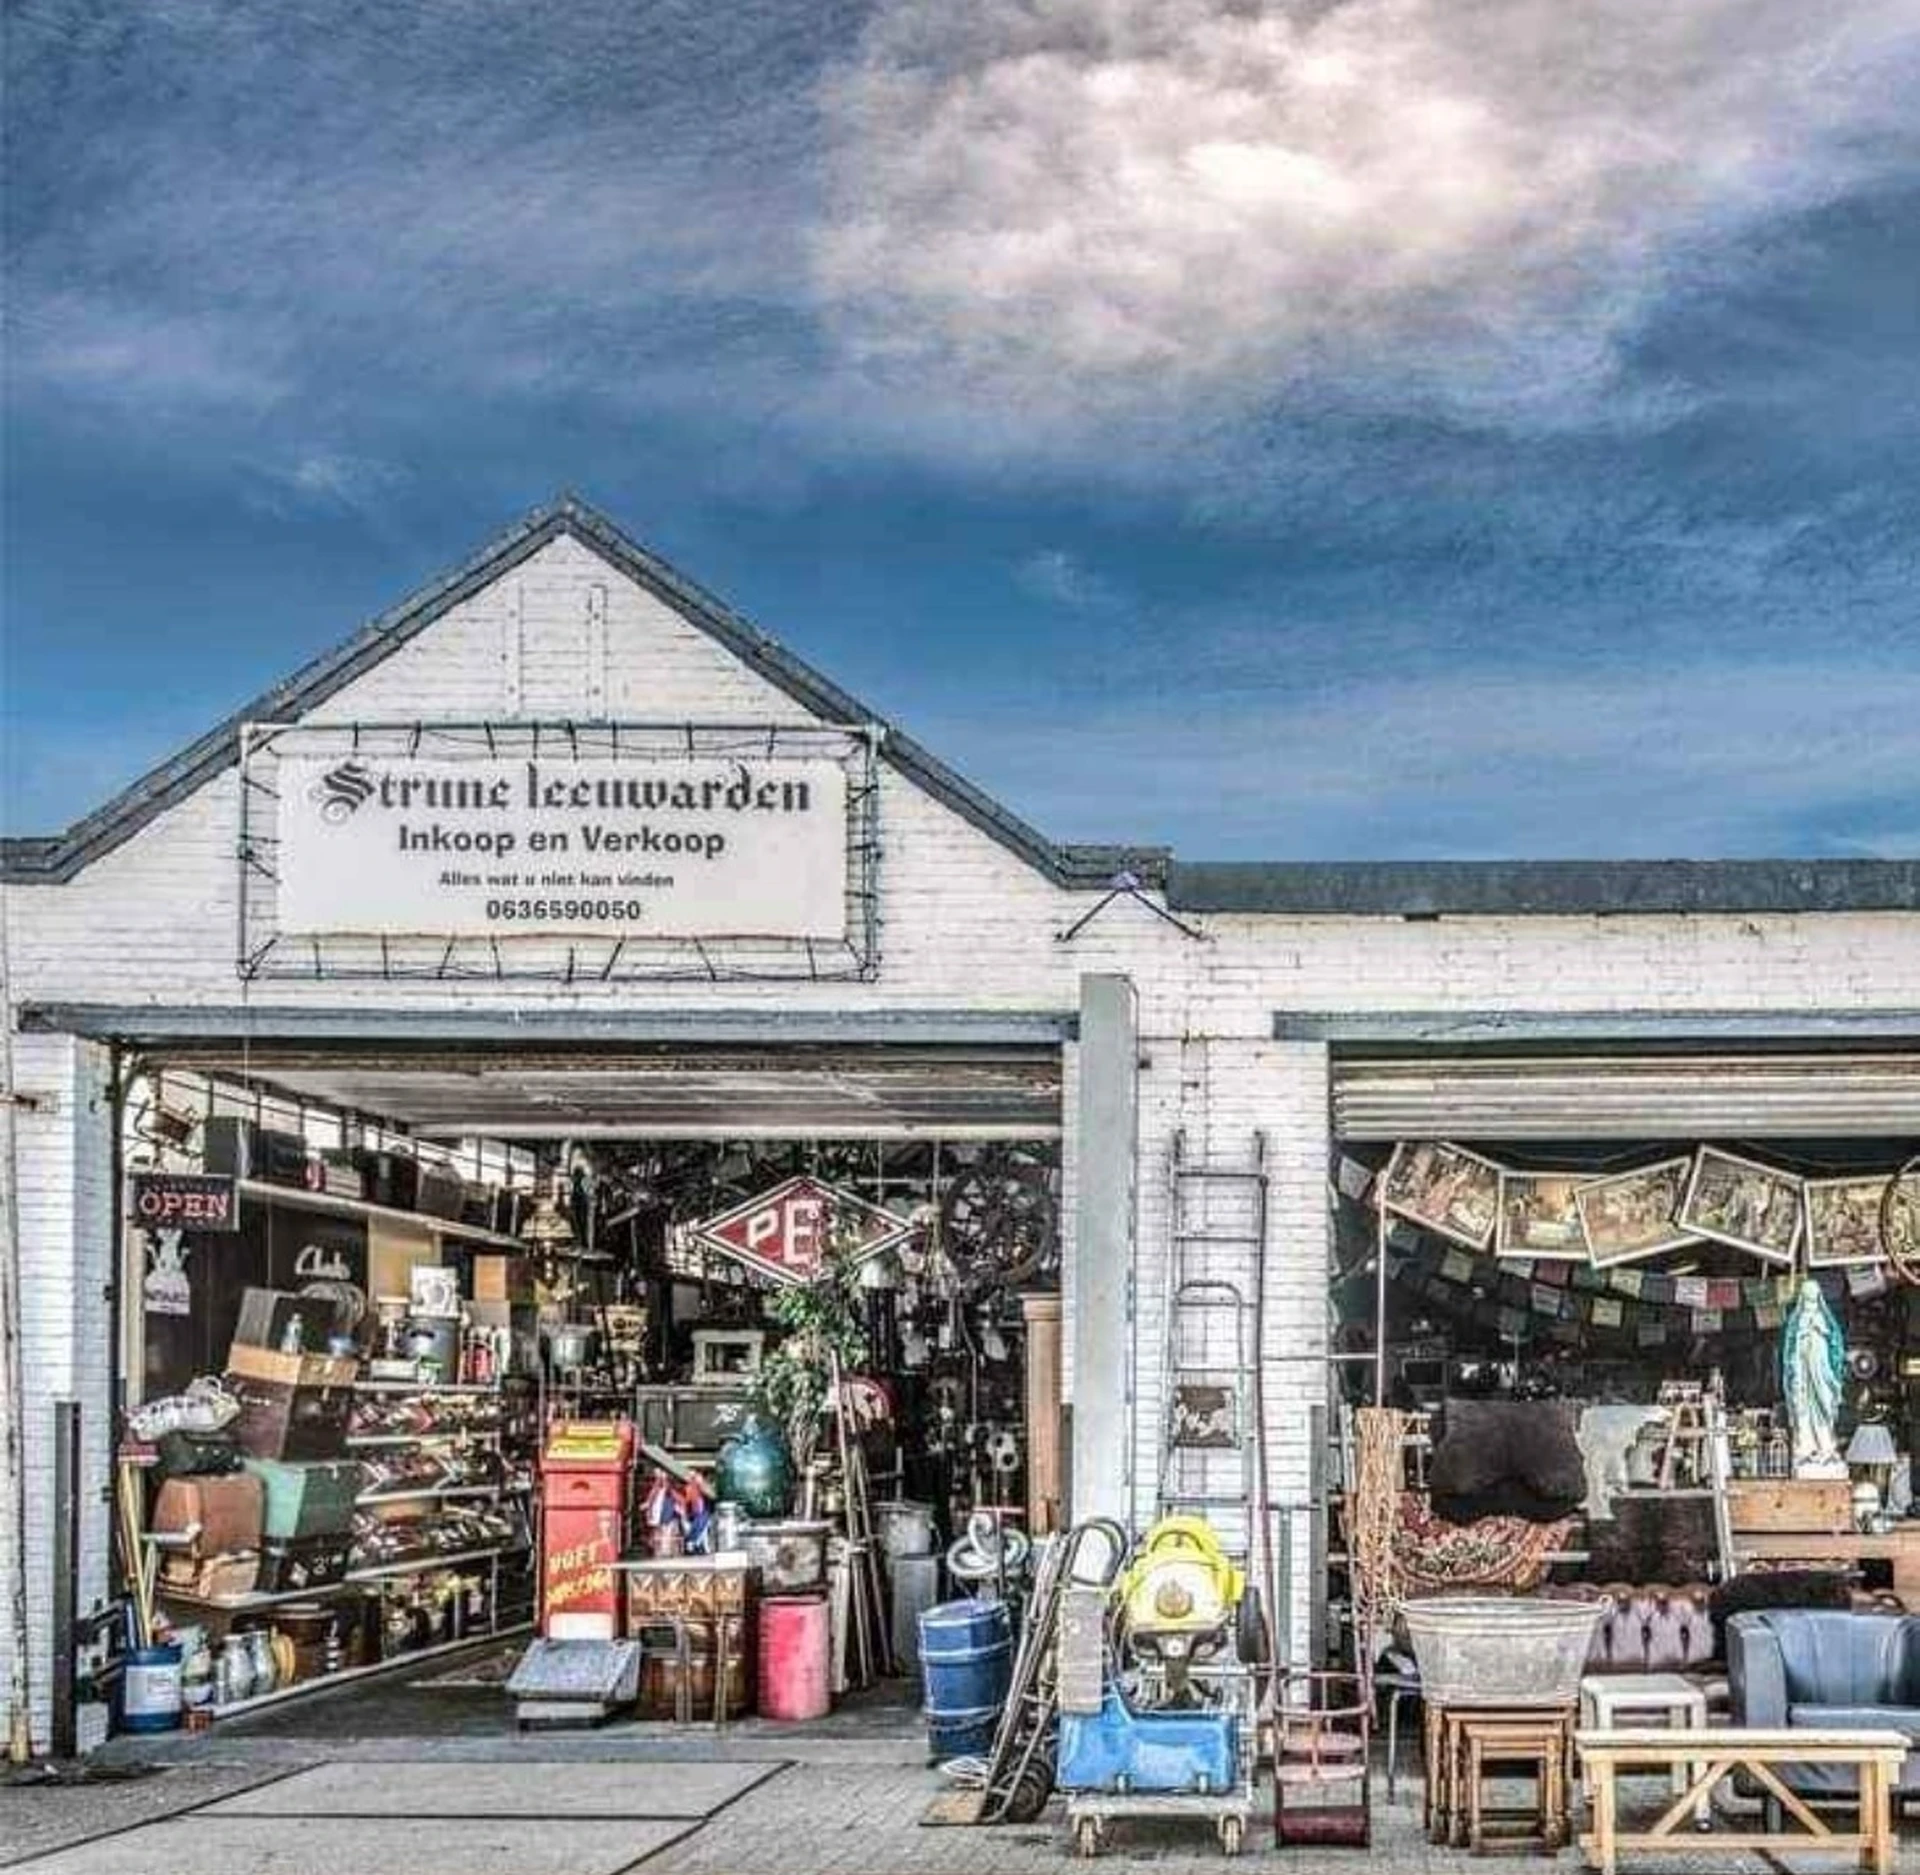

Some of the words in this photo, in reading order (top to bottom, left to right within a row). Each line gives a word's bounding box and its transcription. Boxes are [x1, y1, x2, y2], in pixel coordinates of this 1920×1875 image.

[398, 825, 516, 859] Inkoop
[528, 832, 569, 852] en
[581, 825, 725, 860] Verkoop
[580, 871, 613, 887] kan
[485, 899, 641, 920] 0636590050
[139, 1190, 230, 1219] OPEN
